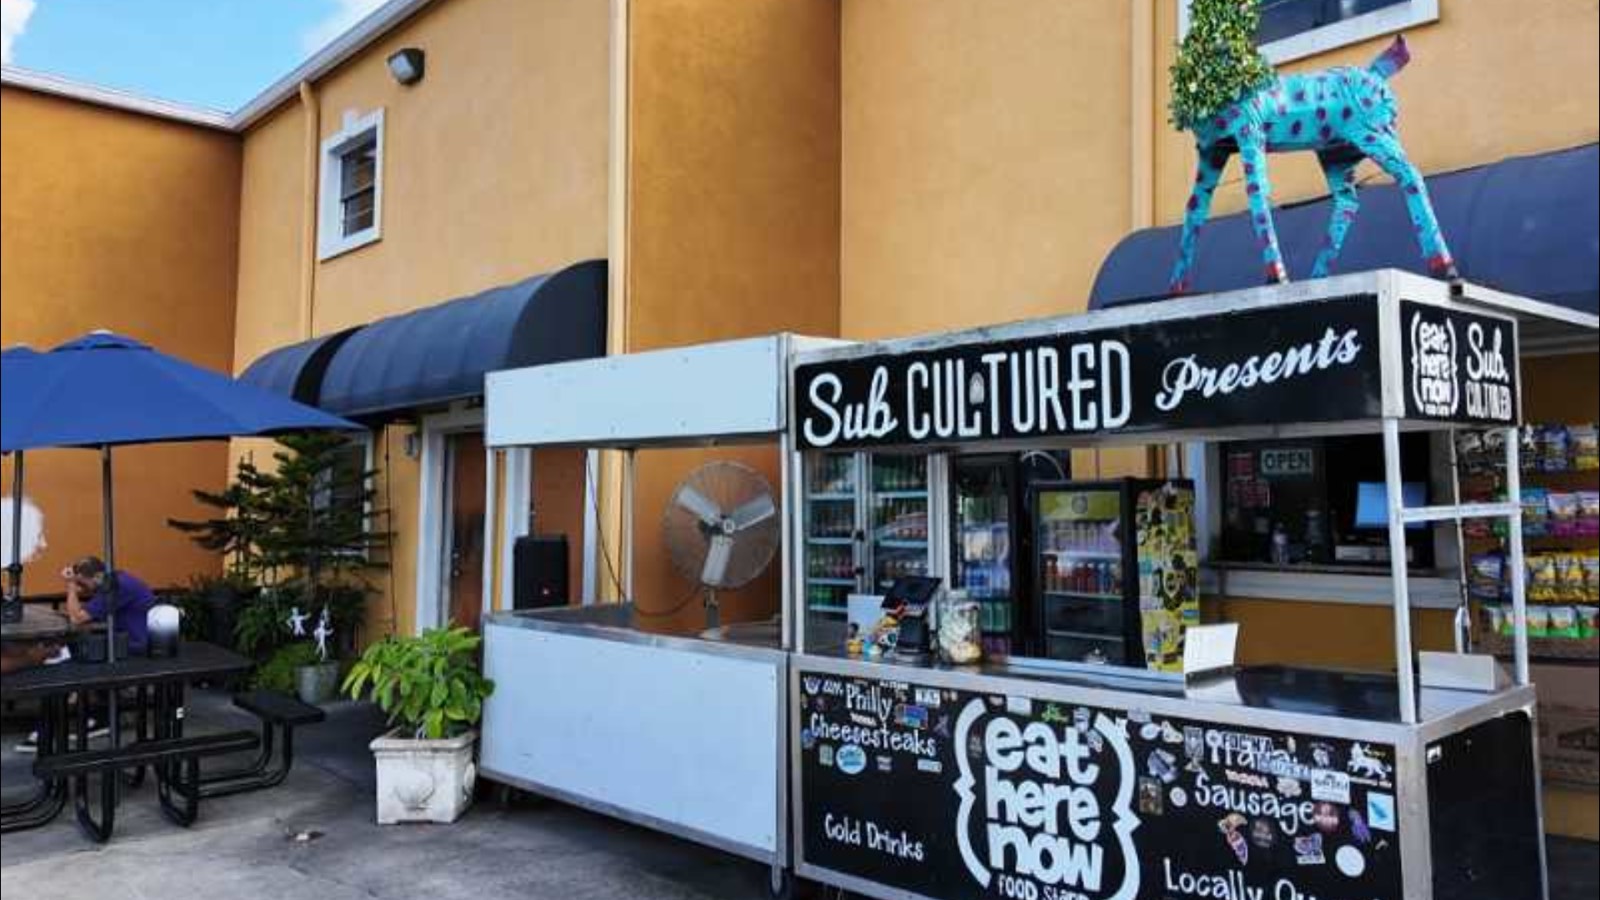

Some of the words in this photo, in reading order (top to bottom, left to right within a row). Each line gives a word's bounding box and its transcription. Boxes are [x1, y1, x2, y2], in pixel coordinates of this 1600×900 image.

[1420, 322, 1450, 354] eat
[803, 365, 898, 447] Sub
[907, 340, 1132, 439] CULTURED
[1155, 326, 1361, 410] Presents
[1420, 349, 1451, 379] here
[1421, 377, 1452, 403] now
[1264, 452, 1312, 470] OPEN
[846, 682, 893, 722] Philly
[811, 712, 937, 757] Cheesesteaks
[985, 717, 1099, 785] eat
[985, 766, 1101, 841] here
[1195, 768, 1314, 835] Sausage
[825, 812, 861, 846] Cold
[866, 822, 924, 861] Drinks
[987, 822, 1103, 891] now
[999, 874, 1038, 900] FOOD
